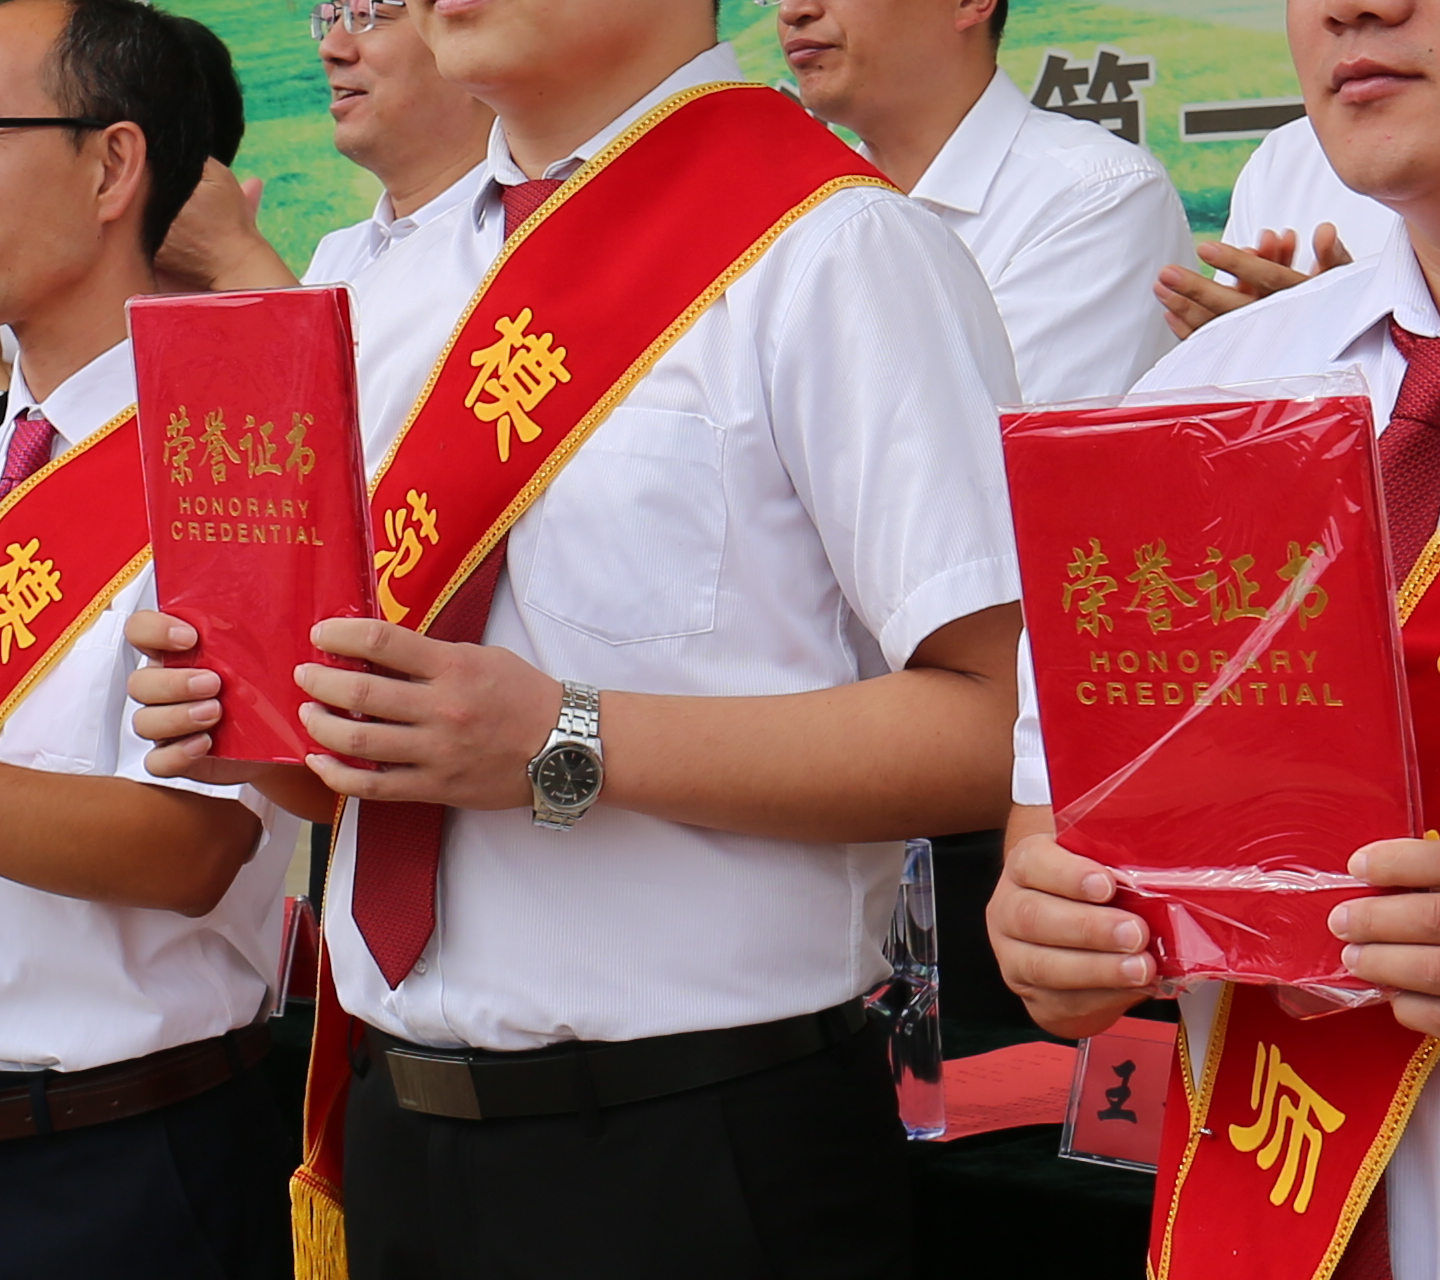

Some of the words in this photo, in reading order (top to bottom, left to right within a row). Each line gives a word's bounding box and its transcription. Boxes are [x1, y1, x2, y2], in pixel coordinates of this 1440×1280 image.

[162, 404, 317, 488] 荣誉证书
[372, 307, 572, 626] 模范
[170, 520, 325, 548] CREDENTIAL
[177, 495, 310, 520] HONORARY
[1061, 536, 1329, 638] 荣誉证书
[1089, 649, 1319, 674] HONORARY
[1075, 680, 1345, 708] CREDENTIAL
[1228, 1039, 1346, 1215] 师
